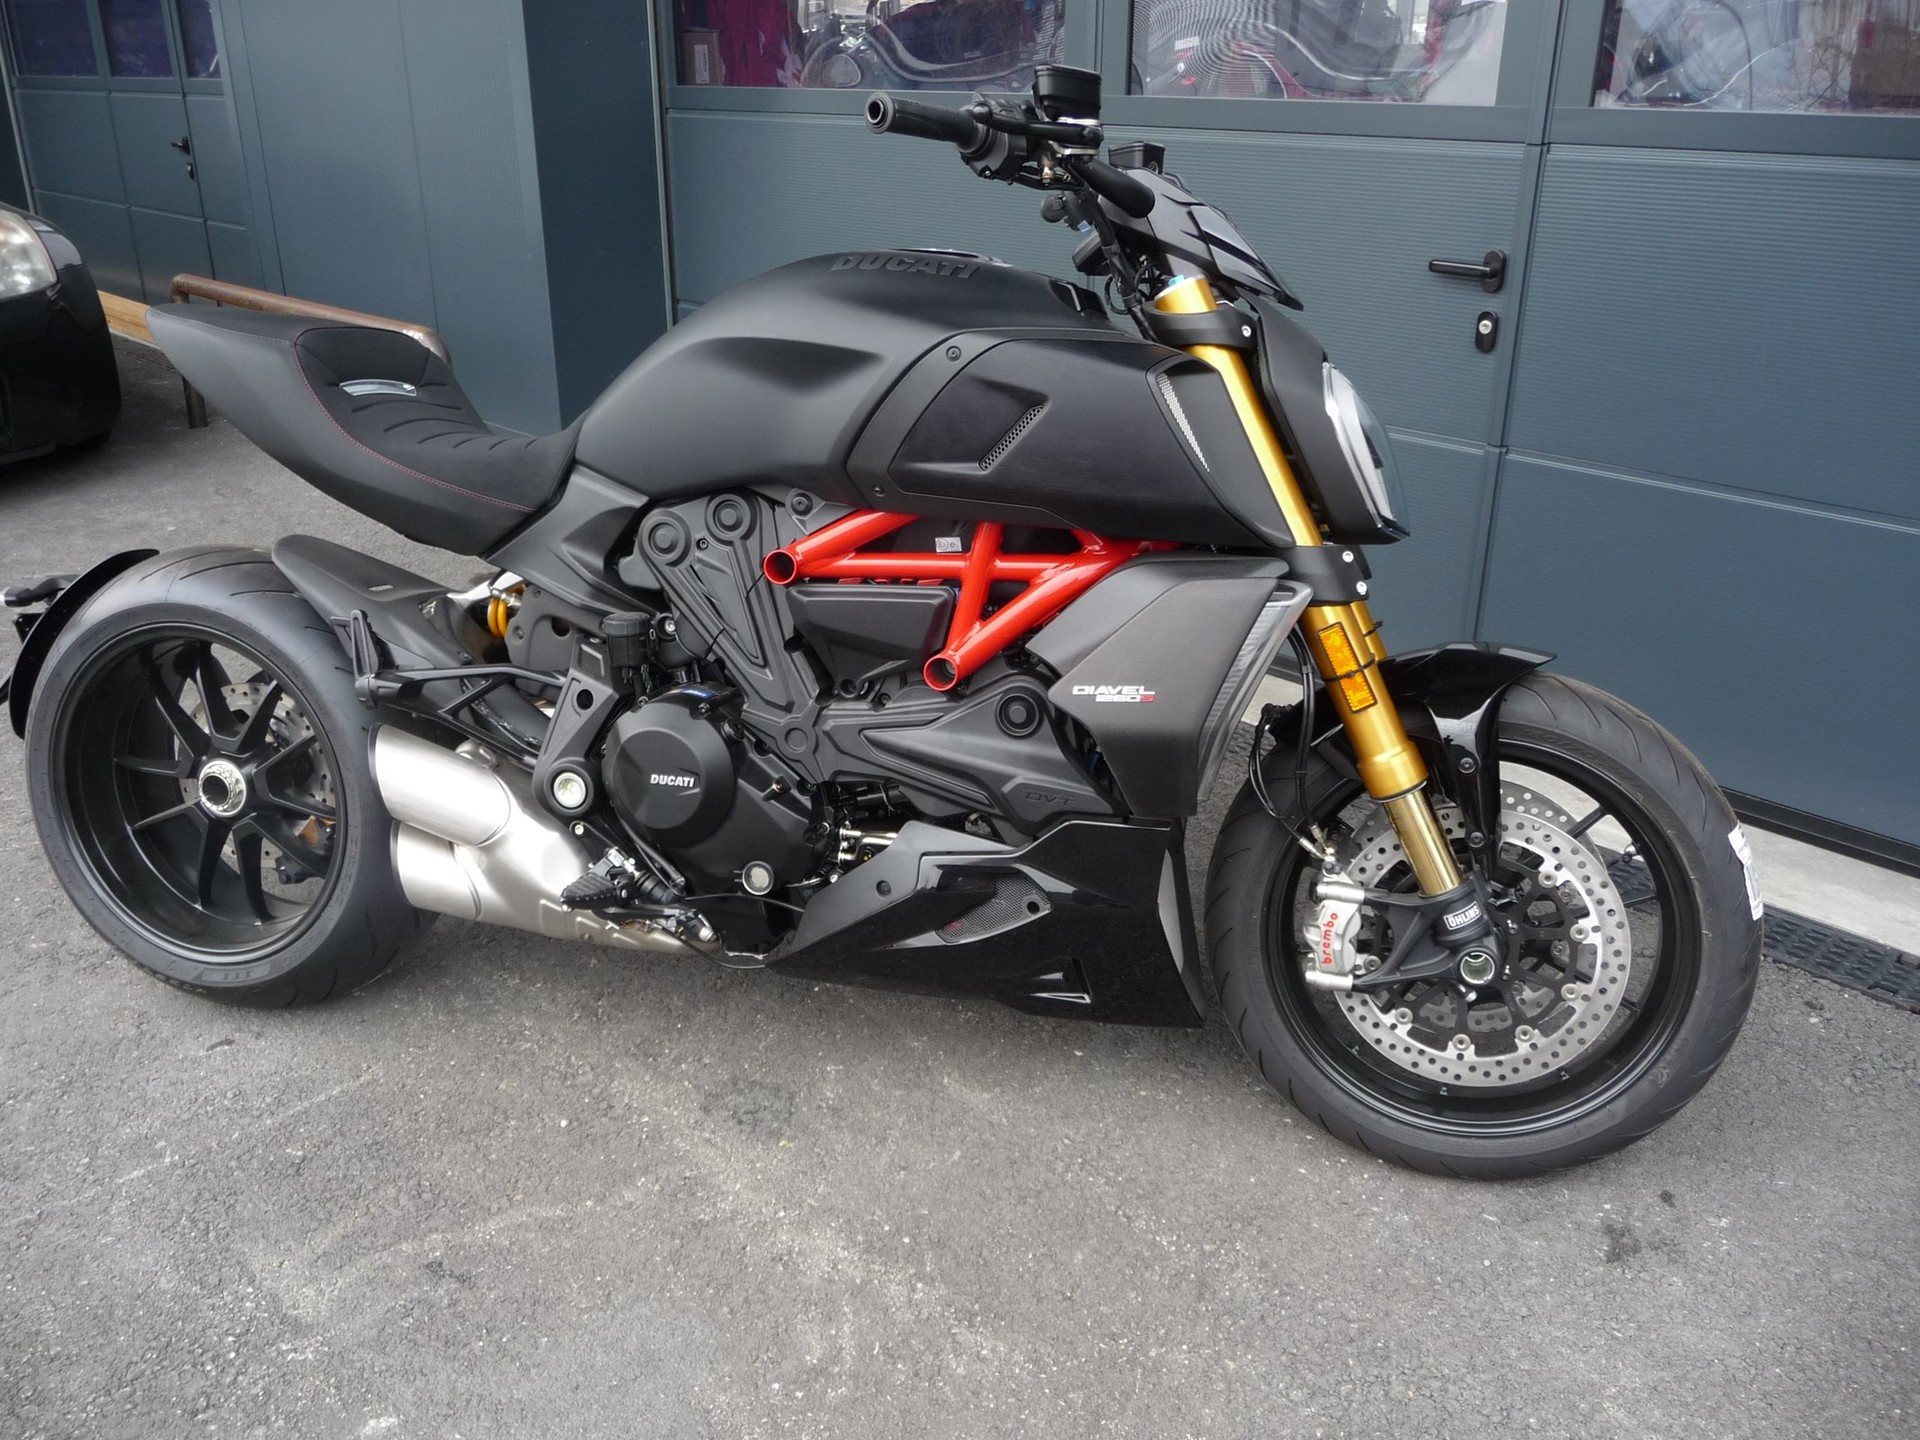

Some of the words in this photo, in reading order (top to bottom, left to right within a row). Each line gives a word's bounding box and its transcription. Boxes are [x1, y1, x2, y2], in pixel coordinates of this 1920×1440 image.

[831, 255, 979, 279] DUCATI
[1072, 685, 1155, 695] DIAVEL
[650, 774, 695, 787] DUCATI
[1321, 912, 1338, 965] brembo
